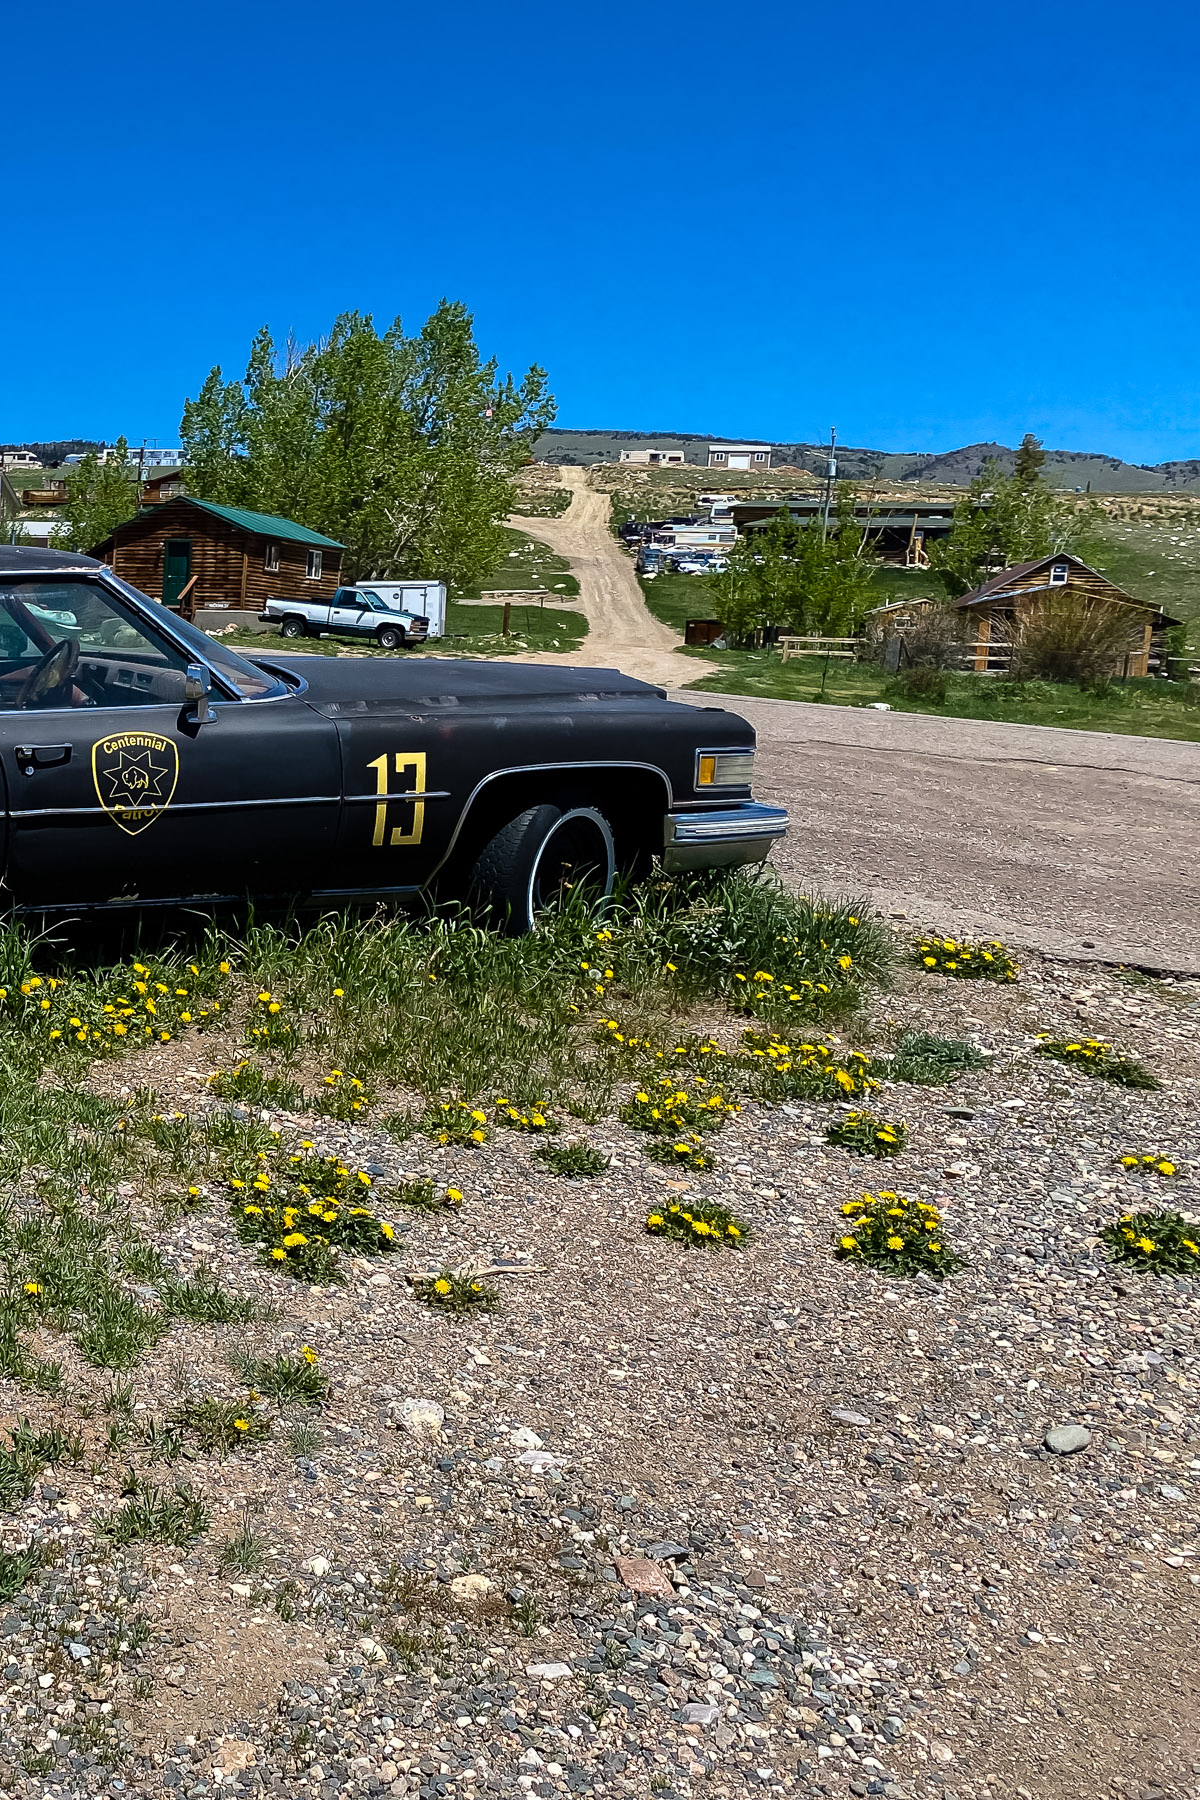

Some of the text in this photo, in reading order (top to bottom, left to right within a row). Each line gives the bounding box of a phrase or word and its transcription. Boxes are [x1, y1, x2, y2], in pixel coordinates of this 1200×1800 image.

[103, 736, 167, 754] Centennial
[366, 752, 426, 846] 13
[112, 802, 159, 820] Patrol
